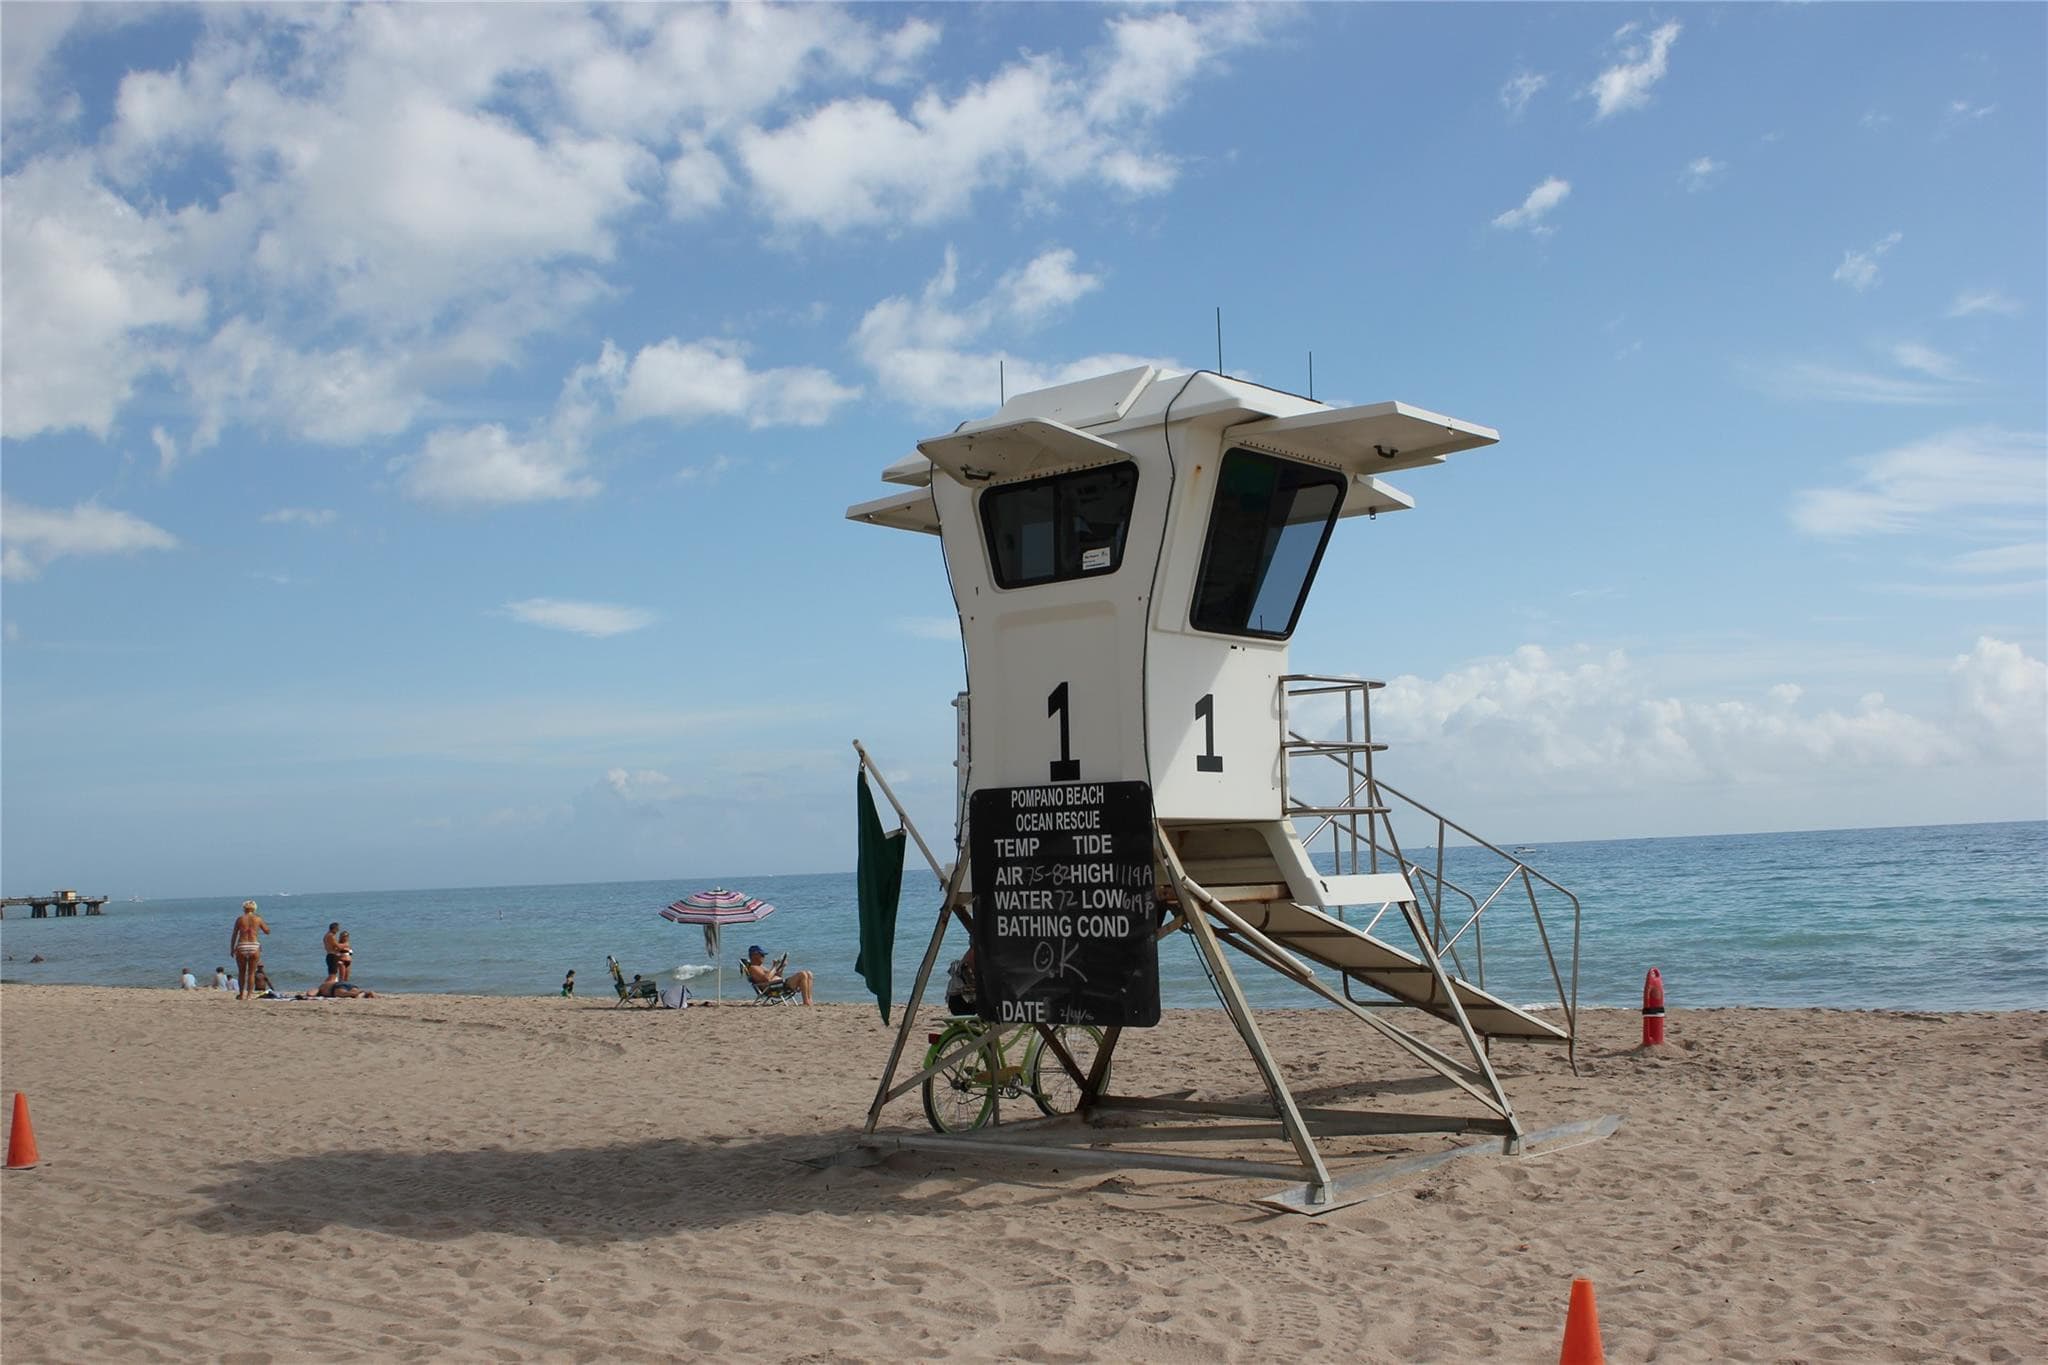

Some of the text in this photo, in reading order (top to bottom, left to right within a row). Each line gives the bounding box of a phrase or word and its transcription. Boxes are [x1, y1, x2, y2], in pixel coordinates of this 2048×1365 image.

[1048, 681, 1080, 782] 1
[1195, 693, 1223, 773] 1
[1011, 785, 1104, 808] POMPANO BEACH
[1016, 810, 1100, 832] OCEAN RESCUE
[994, 837, 1040, 858] TEMP
[1072, 834, 1113, 855] TIDE
[995, 866, 1024, 886] AIR
[1070, 863, 1114, 884] HIGH
[994, 889, 1078, 911] WATER 72
[1082, 889, 1123, 909] LOW
[997, 915, 1130, 938] BATHING COND
[1002, 1000, 1047, 1022] DATE
